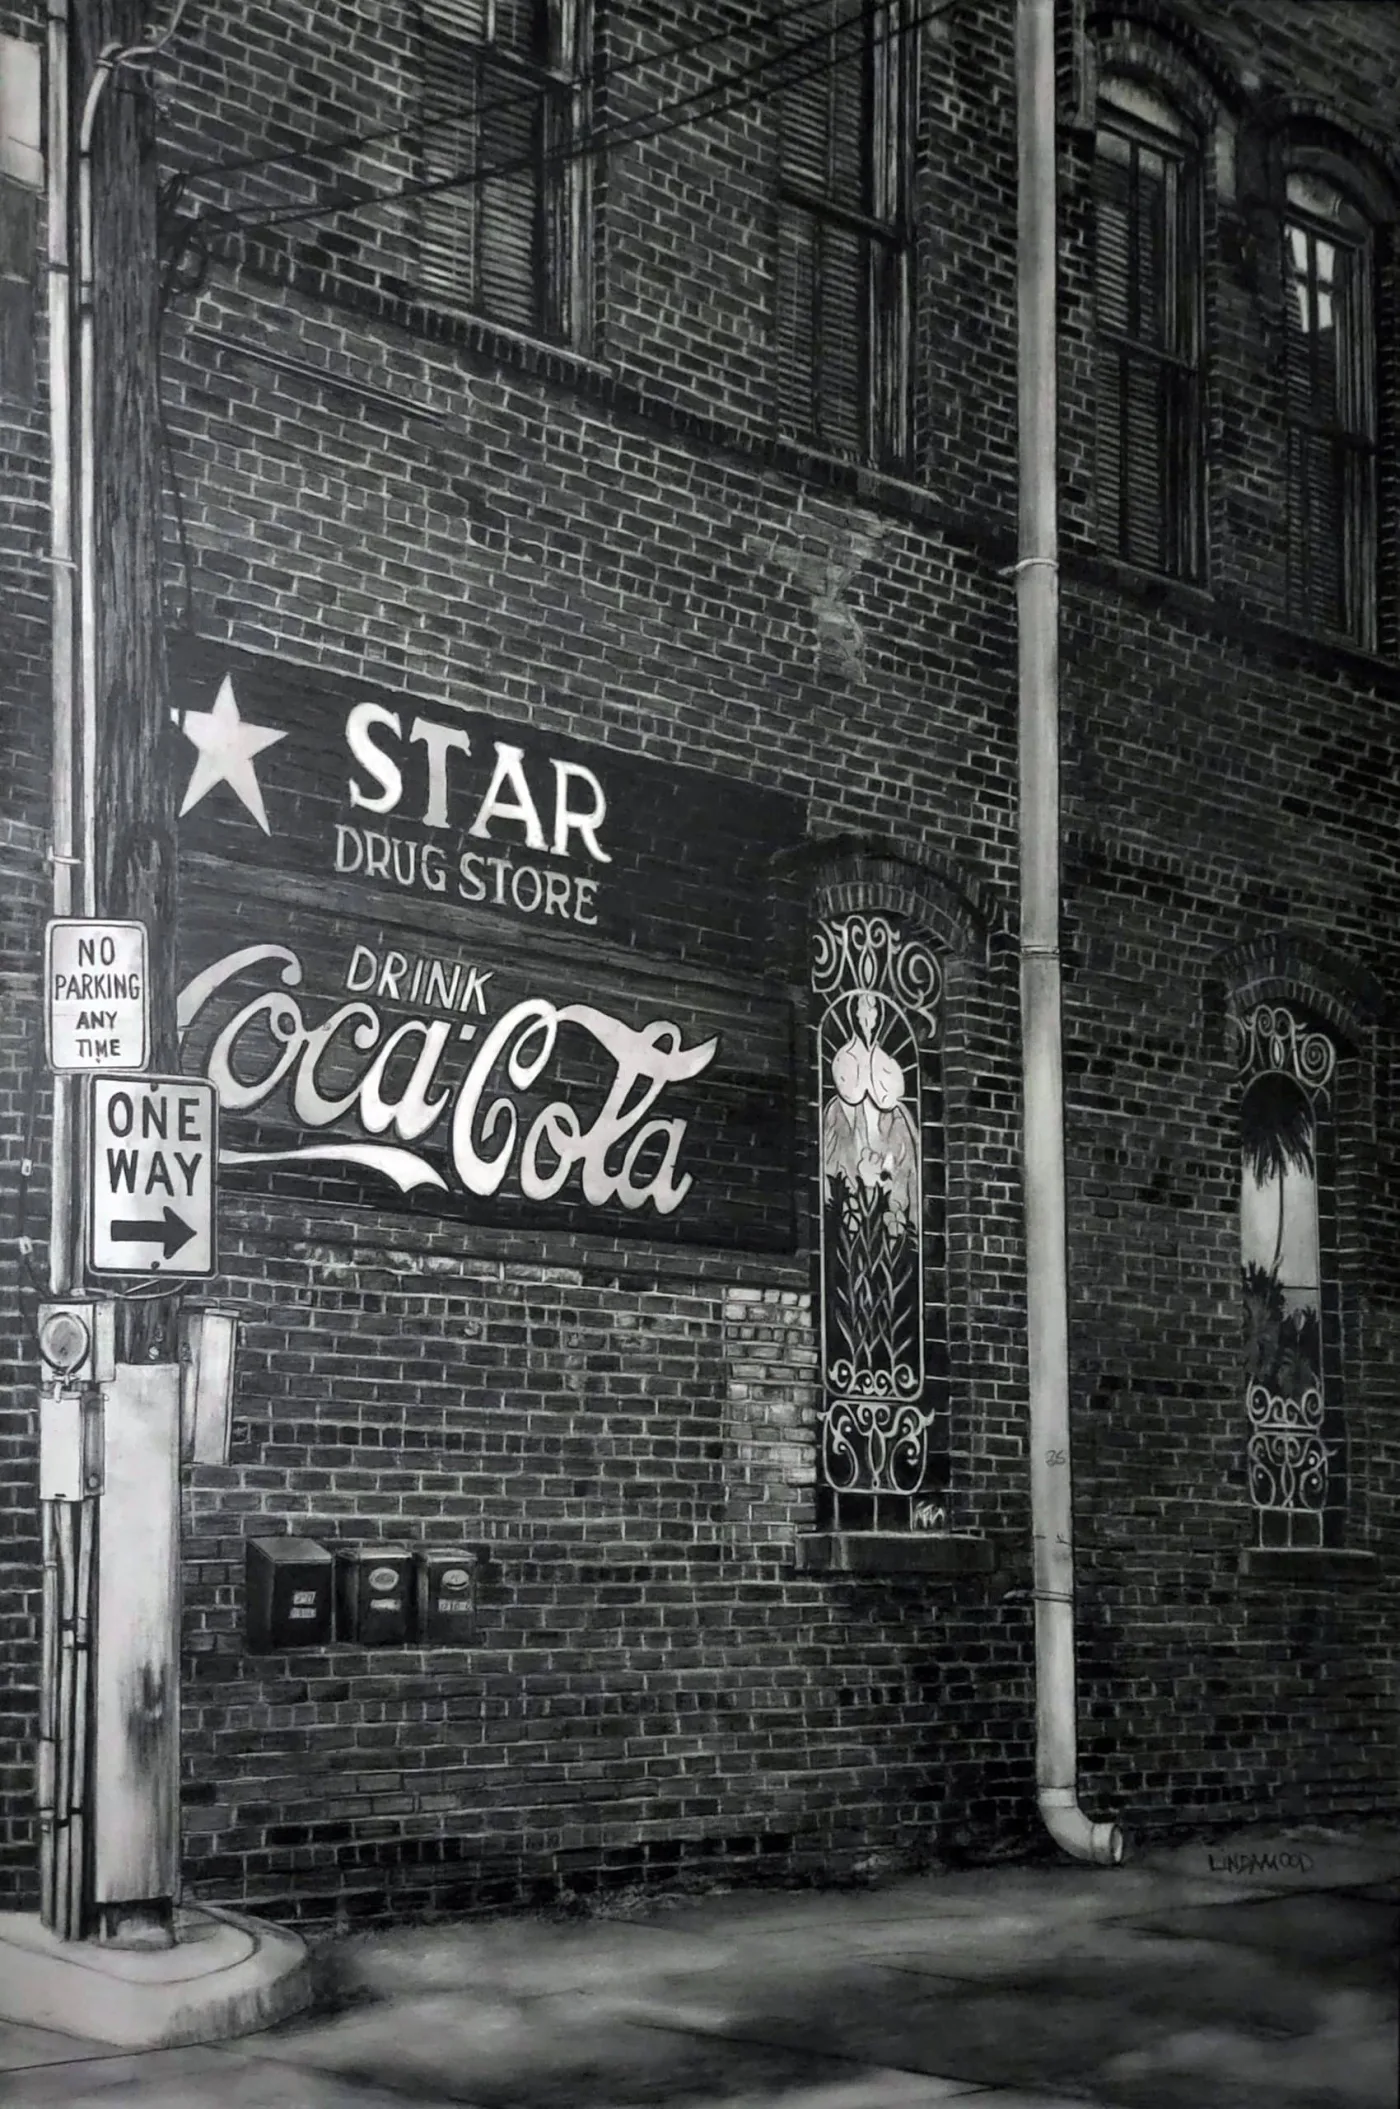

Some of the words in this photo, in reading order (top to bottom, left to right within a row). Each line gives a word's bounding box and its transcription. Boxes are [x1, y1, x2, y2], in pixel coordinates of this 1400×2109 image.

[345, 701, 613, 864] STAR
[334, 823, 447, 892] DRUG
[458, 851, 600, 926] STORE
[78, 935, 116, 967] NO
[54, 972, 141, 1001] PARKING
[346, 943, 495, 1016] DRINK
[75, 1010, 118, 1031] ANY
[75, 1037, 122, 1059] TIME
[107, 1090, 202, 1143] ONE
[106, 1146, 203, 1198] WAY
